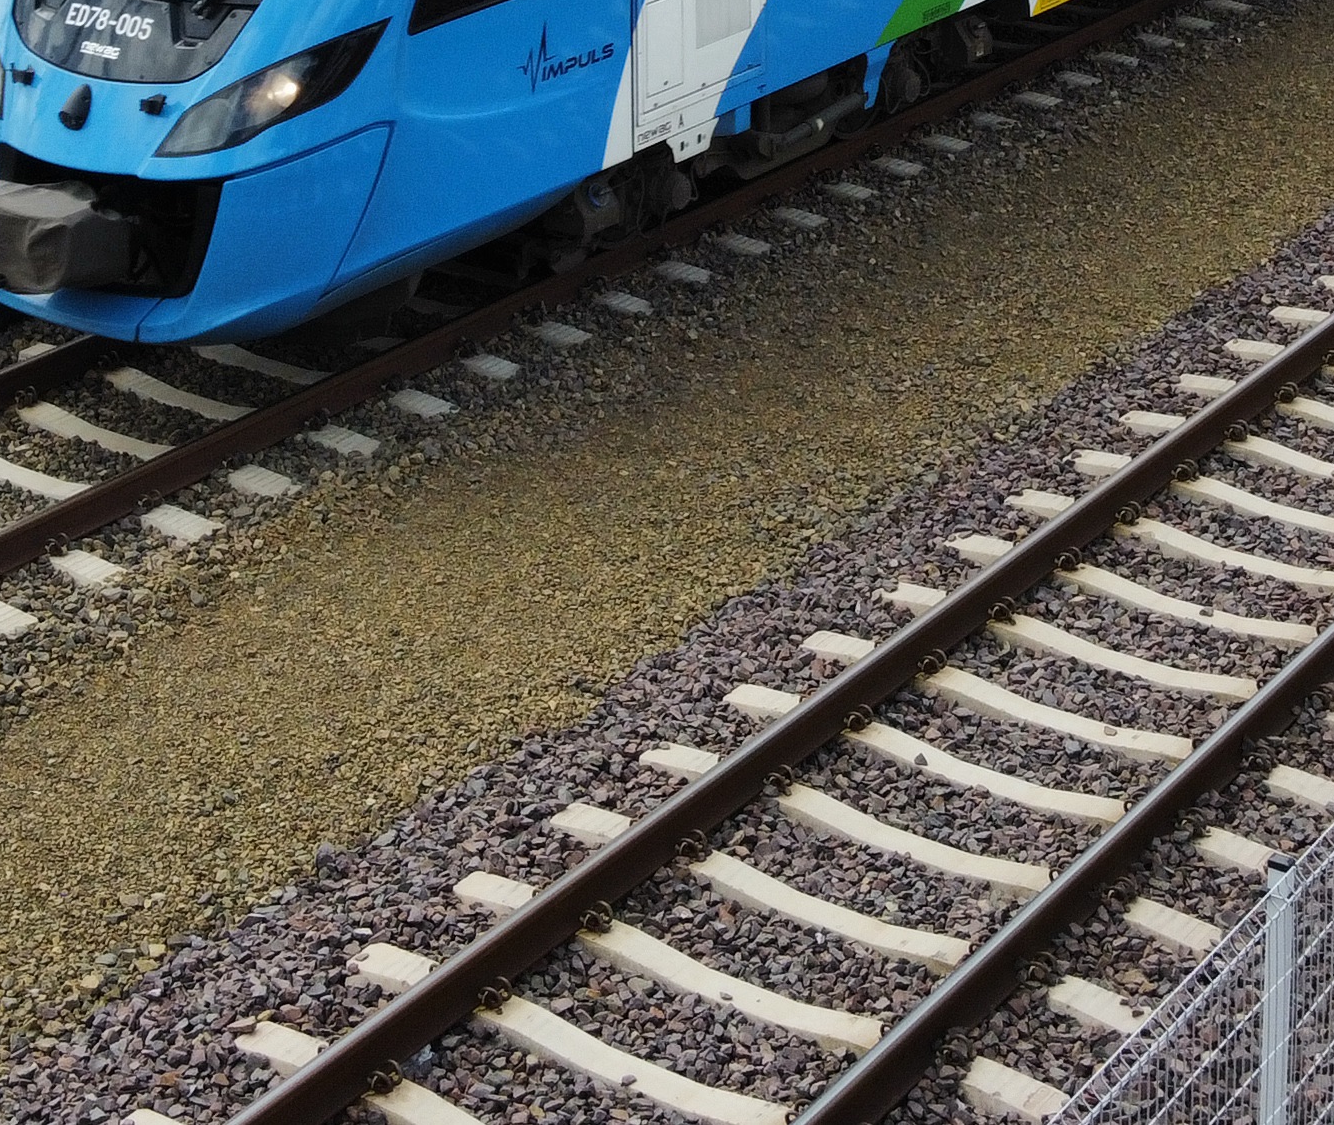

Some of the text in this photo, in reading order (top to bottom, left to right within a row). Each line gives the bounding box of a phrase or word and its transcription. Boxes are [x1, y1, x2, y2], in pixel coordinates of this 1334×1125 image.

[65, 2, 154, 40] ED78-005
[80, 40, 121, 59] newag
[542, 42, 614, 82] IMPULS
[637, 121, 672, 146] newag
